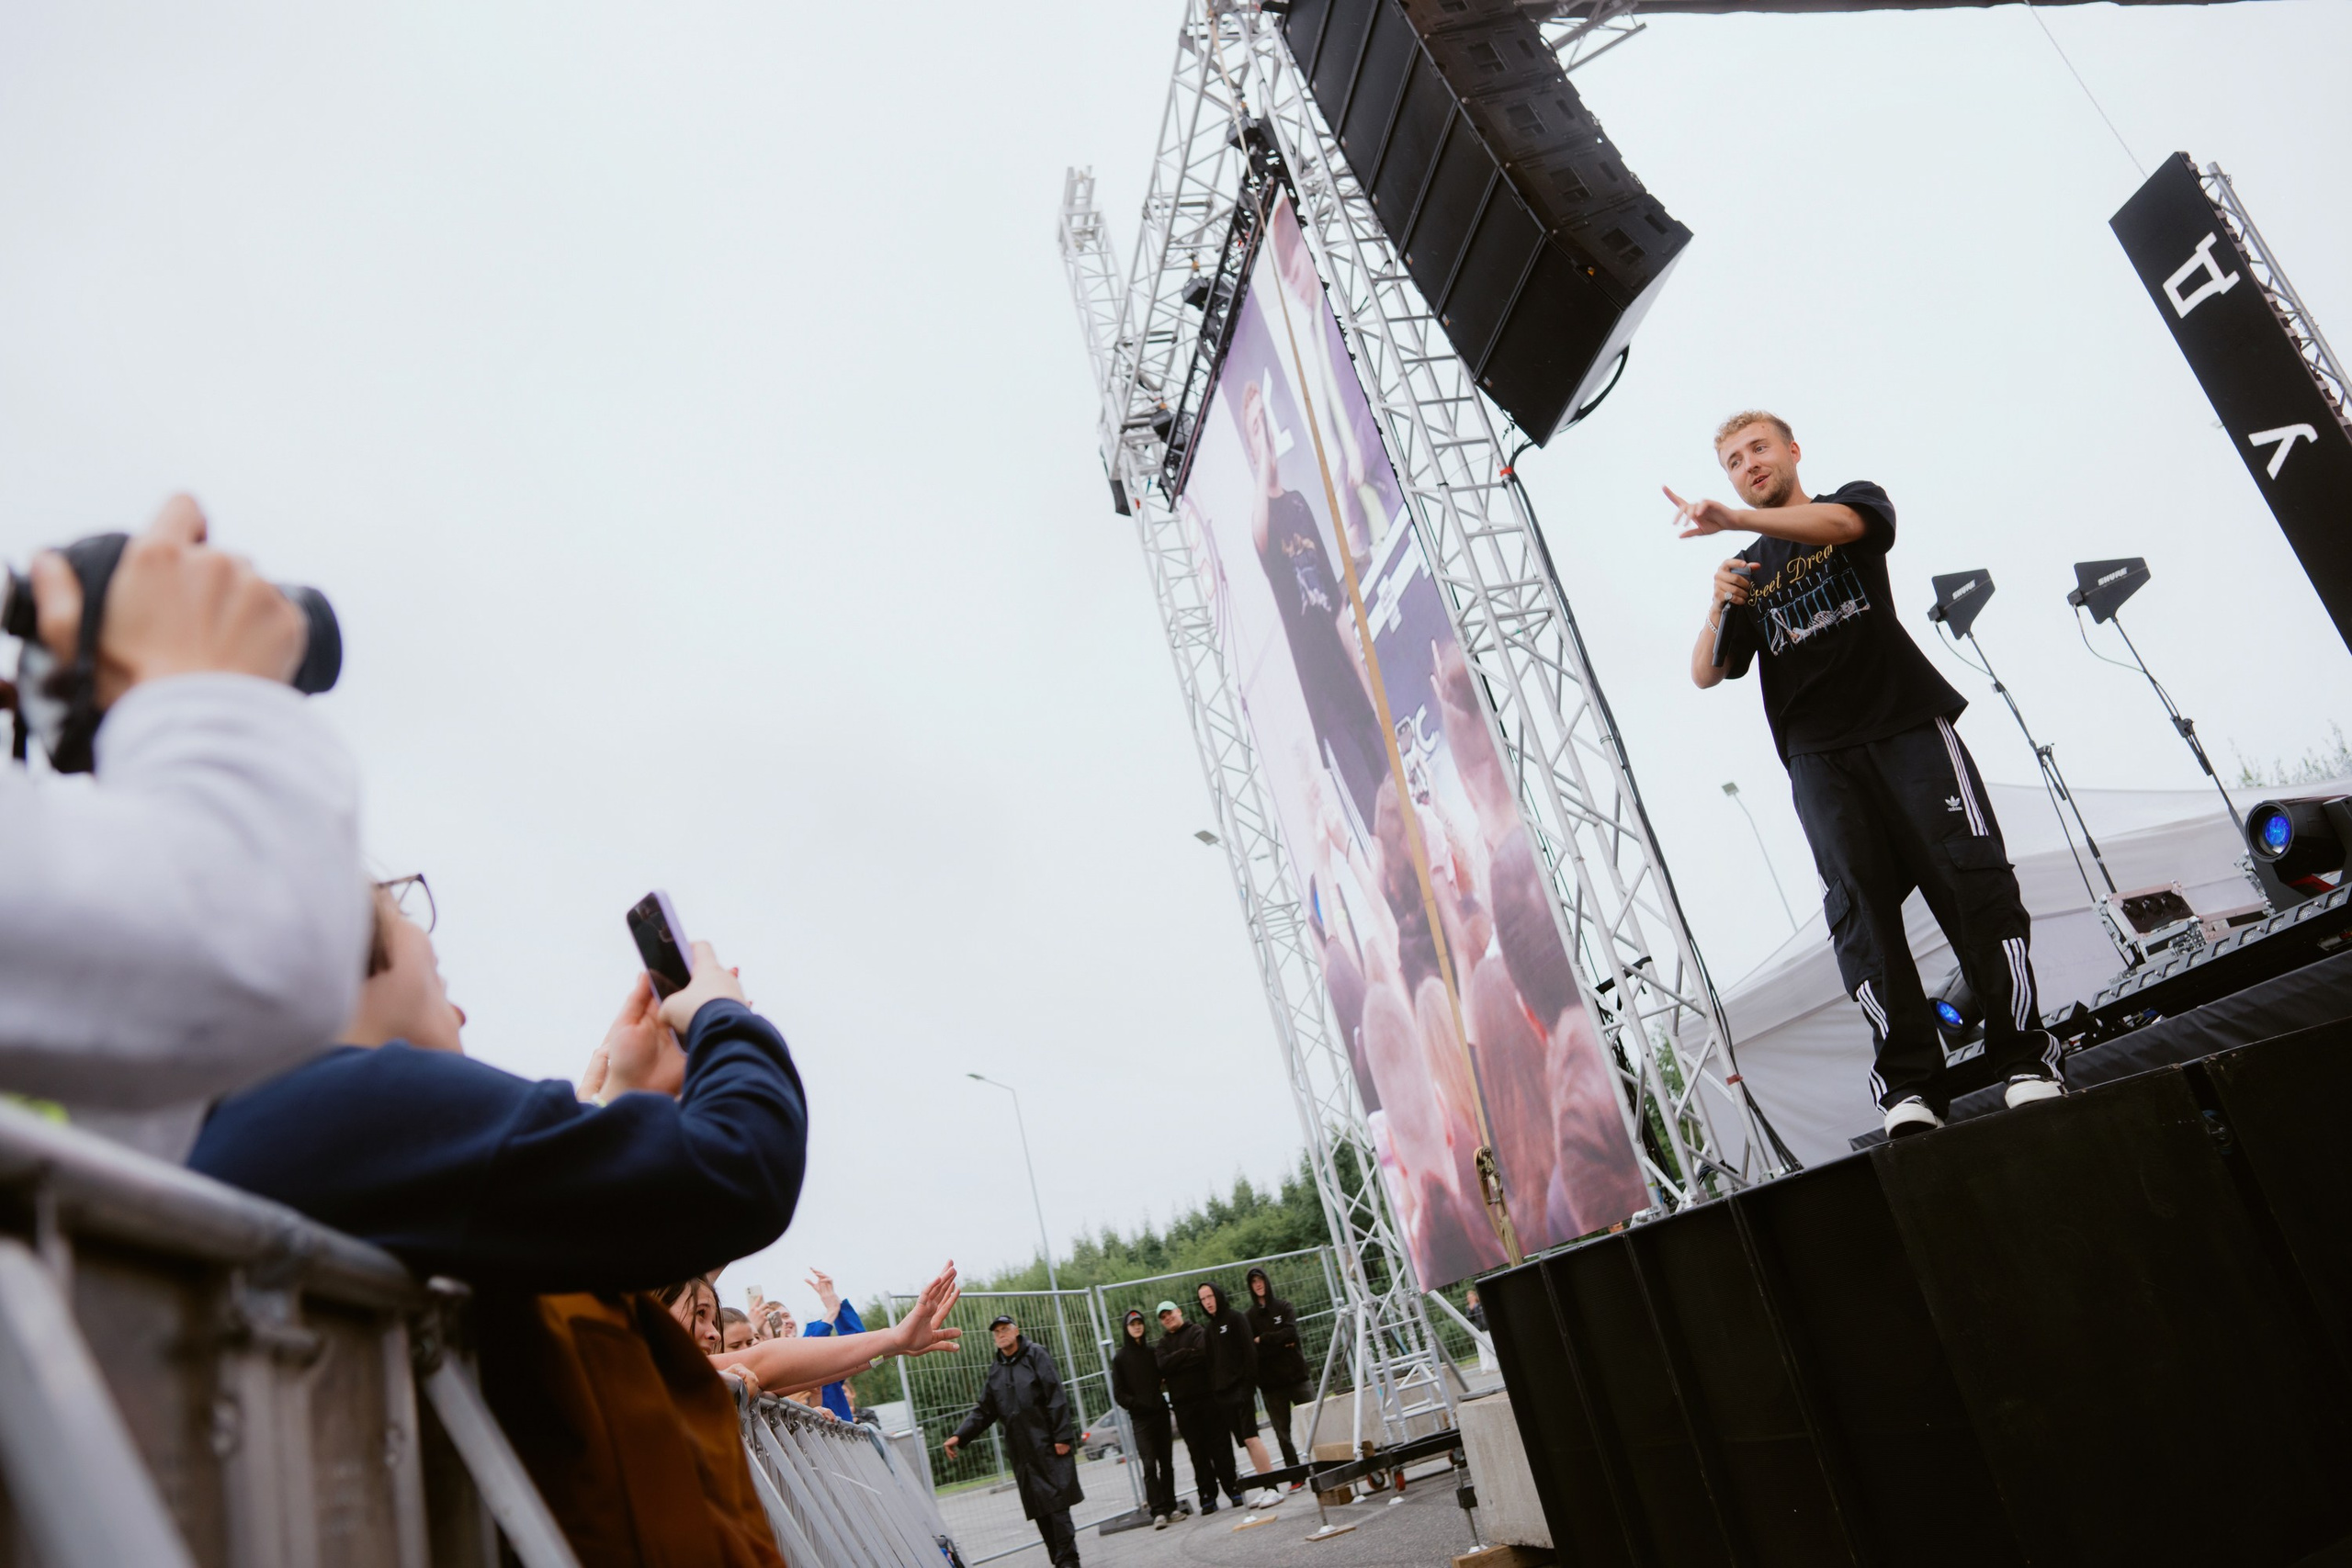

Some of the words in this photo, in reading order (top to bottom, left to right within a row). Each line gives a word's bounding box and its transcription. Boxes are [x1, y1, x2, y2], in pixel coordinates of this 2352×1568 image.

[1786, 544, 1833, 584] Drea
[2097, 566, 2128, 586] SHURE
[1951, 579, 1976, 601] SHURE
